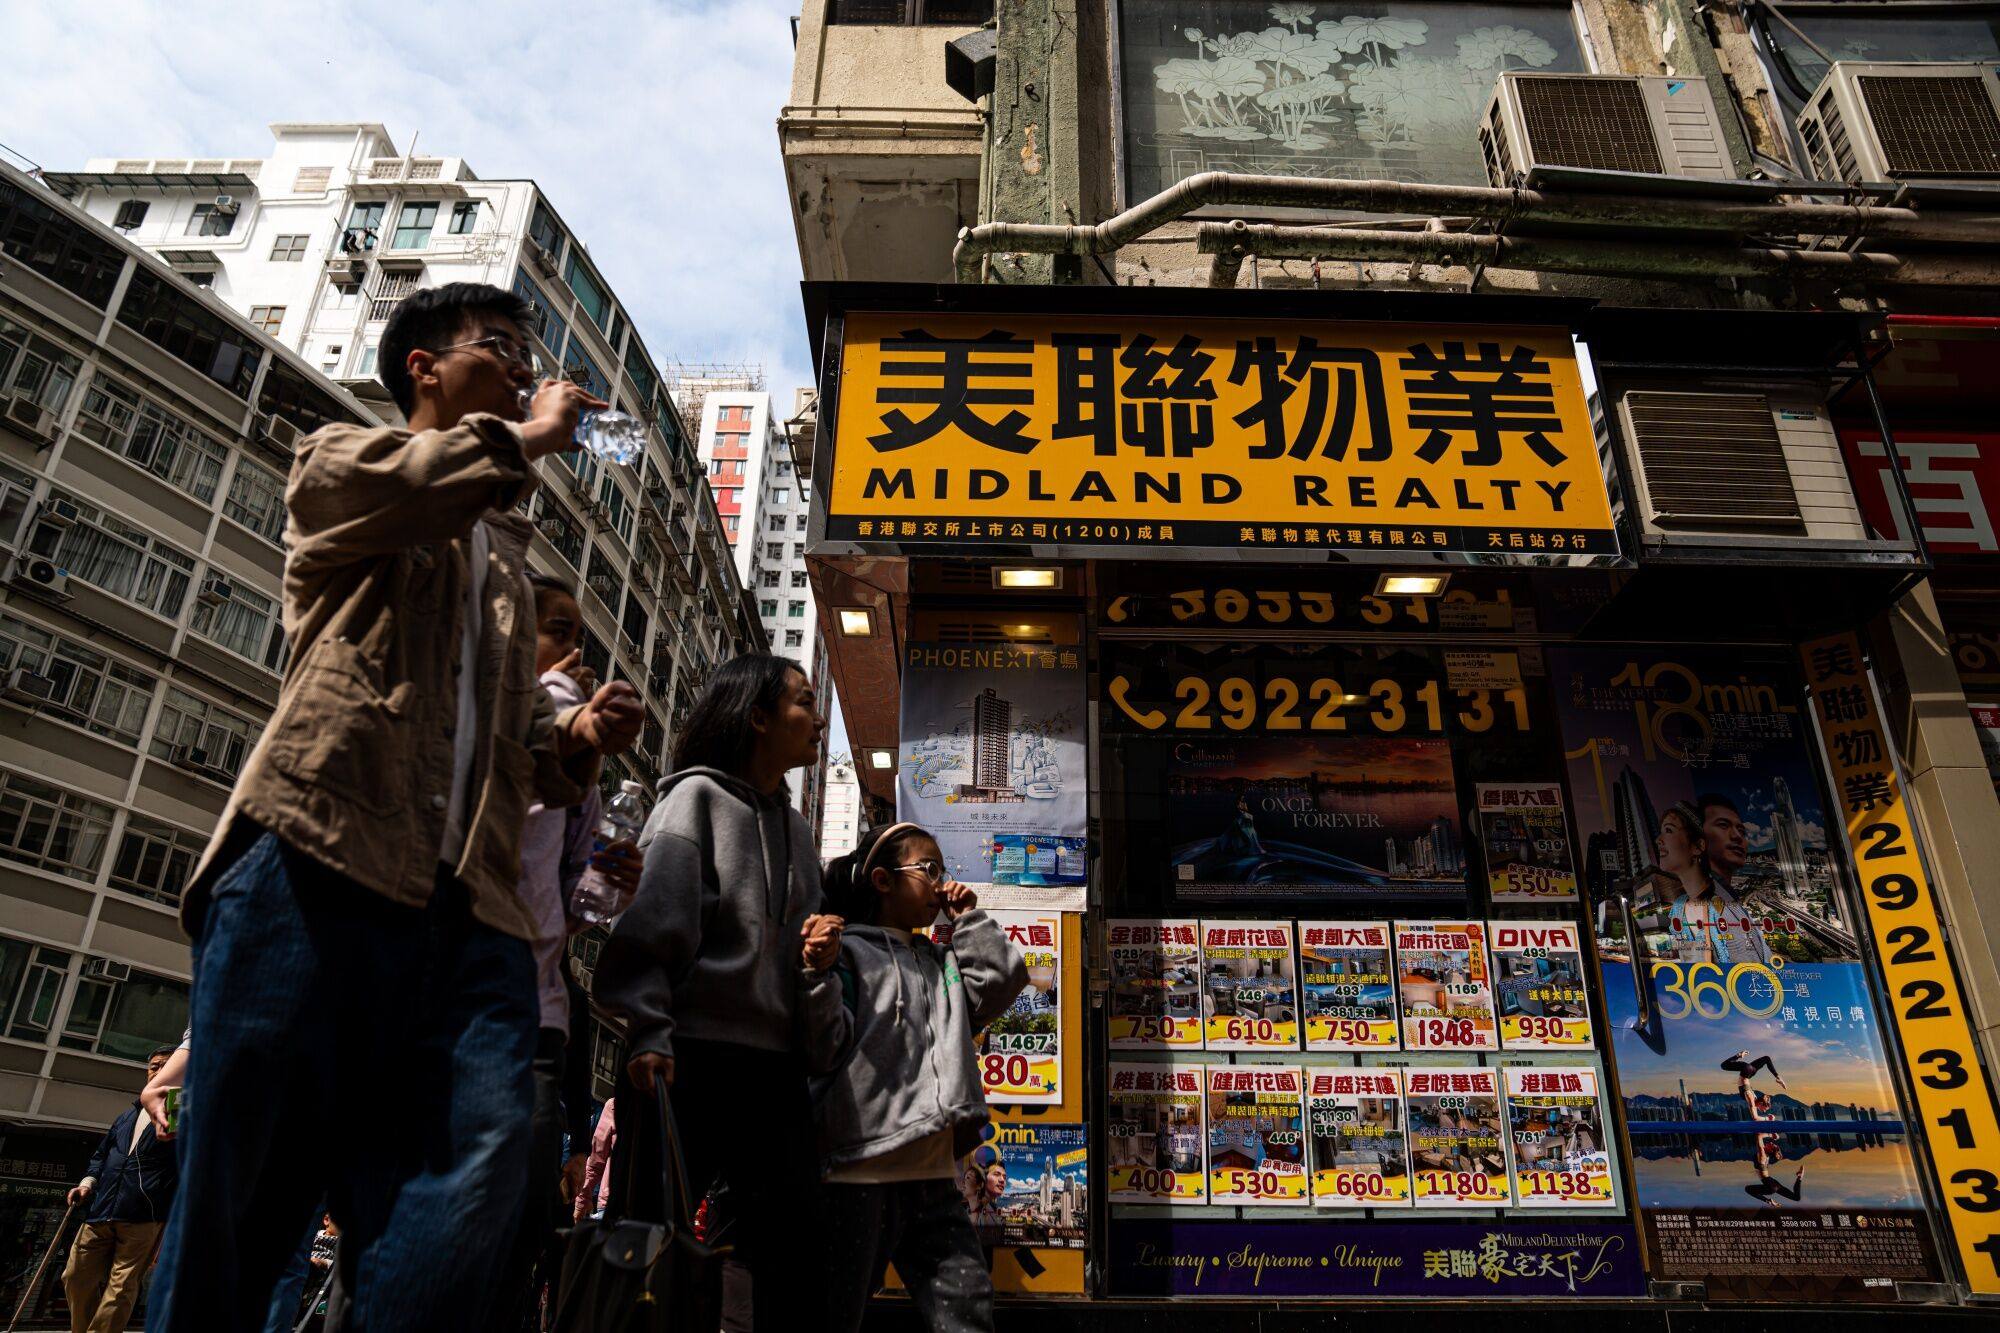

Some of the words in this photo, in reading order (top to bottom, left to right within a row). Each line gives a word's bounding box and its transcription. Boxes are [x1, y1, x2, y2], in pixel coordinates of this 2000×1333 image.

[866, 328, 1568, 467] 美聯物業
[864, 468, 1243, 505] MIDLAND
[1295, 475, 1572, 512] REALTY
[1857, 441, 1999, 552] 百
[858, 521, 1175, 541] 香港聯交所上市公司(1200)成員
[1240, 527, 1447, 546] 美聯物業代理有限公司
[1488, 533, 1587, 549] 天后站分行
[909, 648, 1034, 669] PHOENEXT
[1175, 676, 1347, 730] 2922
[1369, 679, 1531, 732] 3131
[1810, 643, 1896, 813] 美聯物業
[1261, 796, 1318, 812] ONCE.
[1293, 812, 1384, 829] FOREVER.
[1859, 822, 1953, 1021] 2922
[1206, 928, 1288, 946] 健威花園
[1305, 928, 1385, 946] 華凱大廈
[1398, 934, 1470, 950] 城市花園
[1497, 929, 1571, 947] DIVA
[1522, 947, 1550, 958] 493'
[1237, 989, 1266, 1001] 446'
[1781, 1006, 1865, 1021] 傲視同儕
[998, 1034, 1054, 1051] 1467'
[1212, 1072, 1297, 1092] 健威花園
[1312, 1075, 1398, 1095] 昌盛洋樓
[1410, 1073, 1493, 1093] 君悅華庭
[1521, 1073, 1583, 1093] 港運城
[1269, 1133, 1301, 1144] 446'
[1133, 1242, 1207, 1287] Luxury
[1227, 1243, 1314, 1287] Supreme
[1334, 1244, 1404, 1287] Unique
